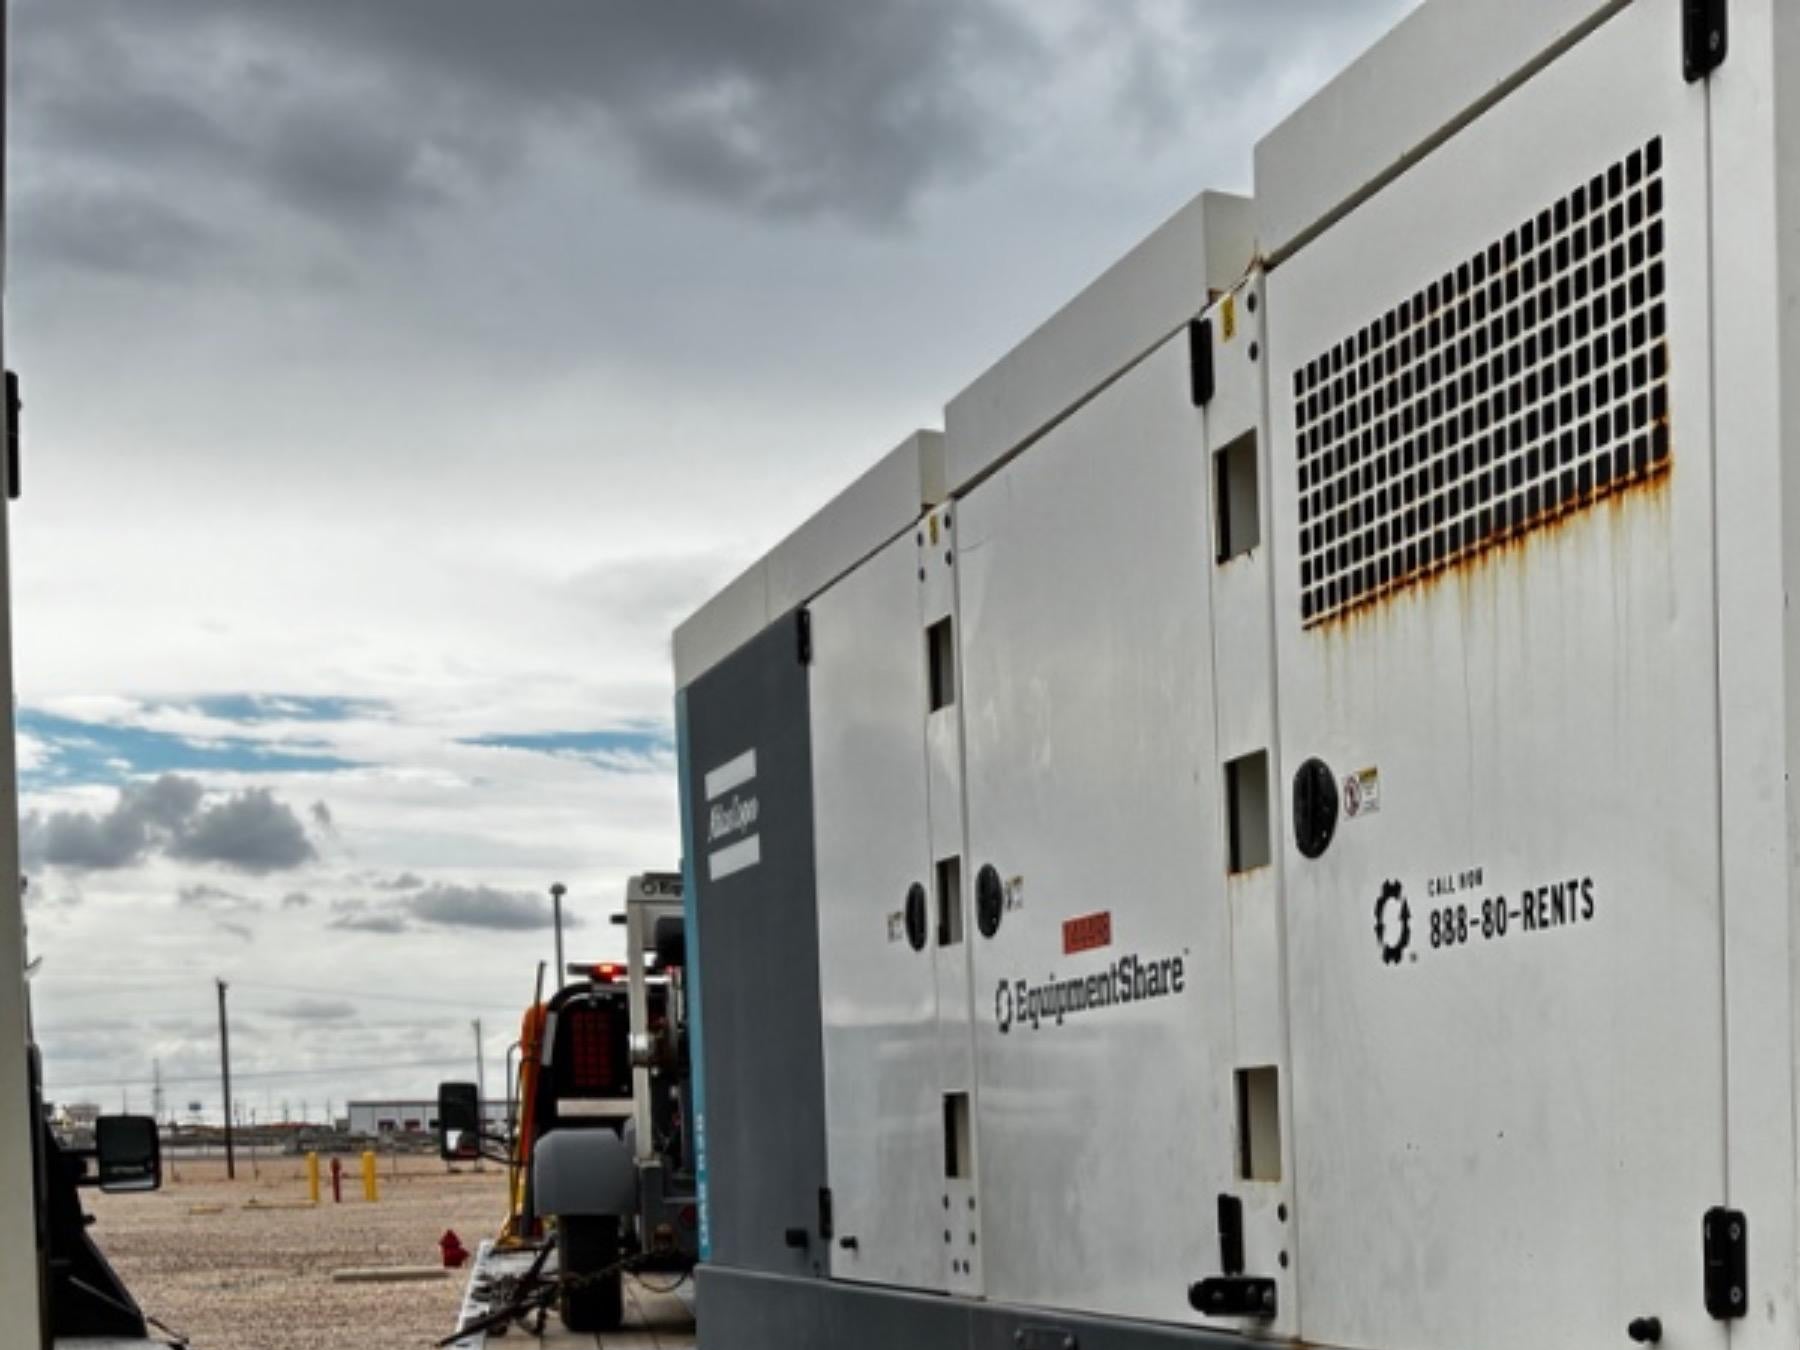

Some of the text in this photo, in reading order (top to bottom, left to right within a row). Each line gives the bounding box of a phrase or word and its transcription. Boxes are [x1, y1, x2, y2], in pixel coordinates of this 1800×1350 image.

[1427, 866, 1483, 897] CALL NOW
[1429, 876, 1595, 950] 888-80-RENTS
[1015, 952, 1185, 1030] EquipmentShare
